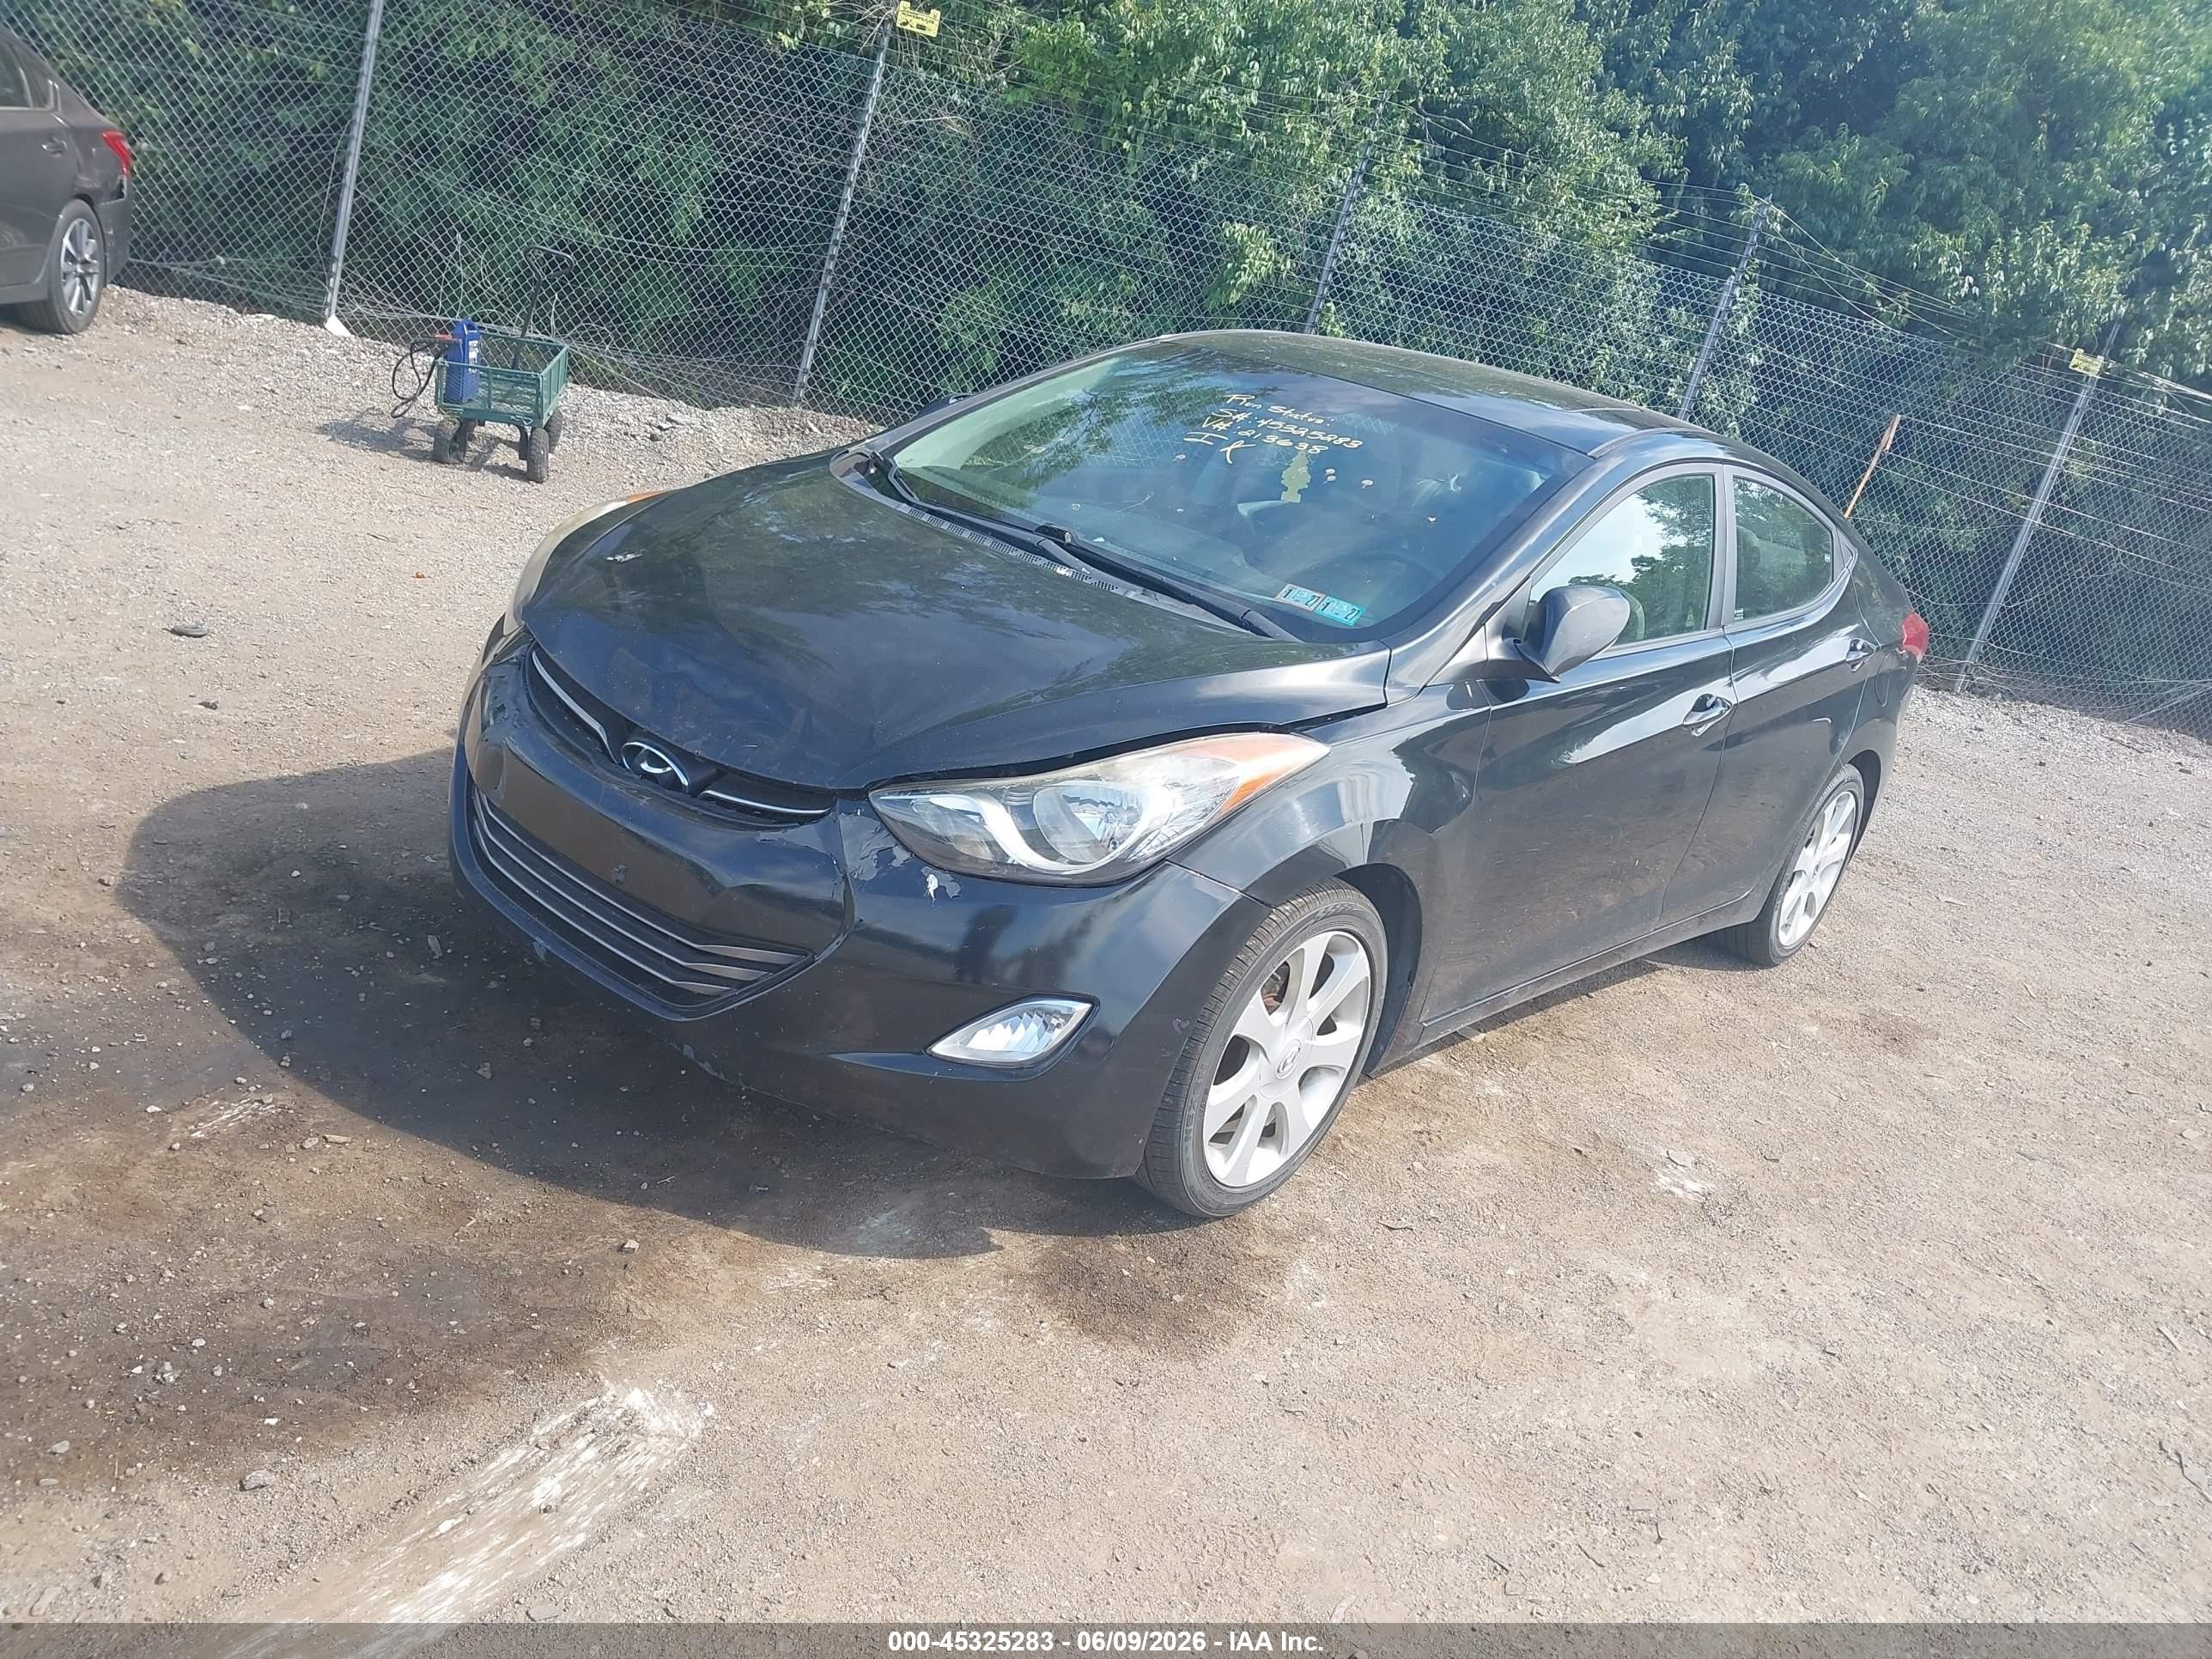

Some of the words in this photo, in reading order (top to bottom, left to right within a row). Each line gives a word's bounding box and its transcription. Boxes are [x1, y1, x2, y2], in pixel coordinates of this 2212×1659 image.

[1223, 393, 1262, 410] Run
[1305, 594, 1321, 608] 27
[1345, 608, 1361, 621] 27
